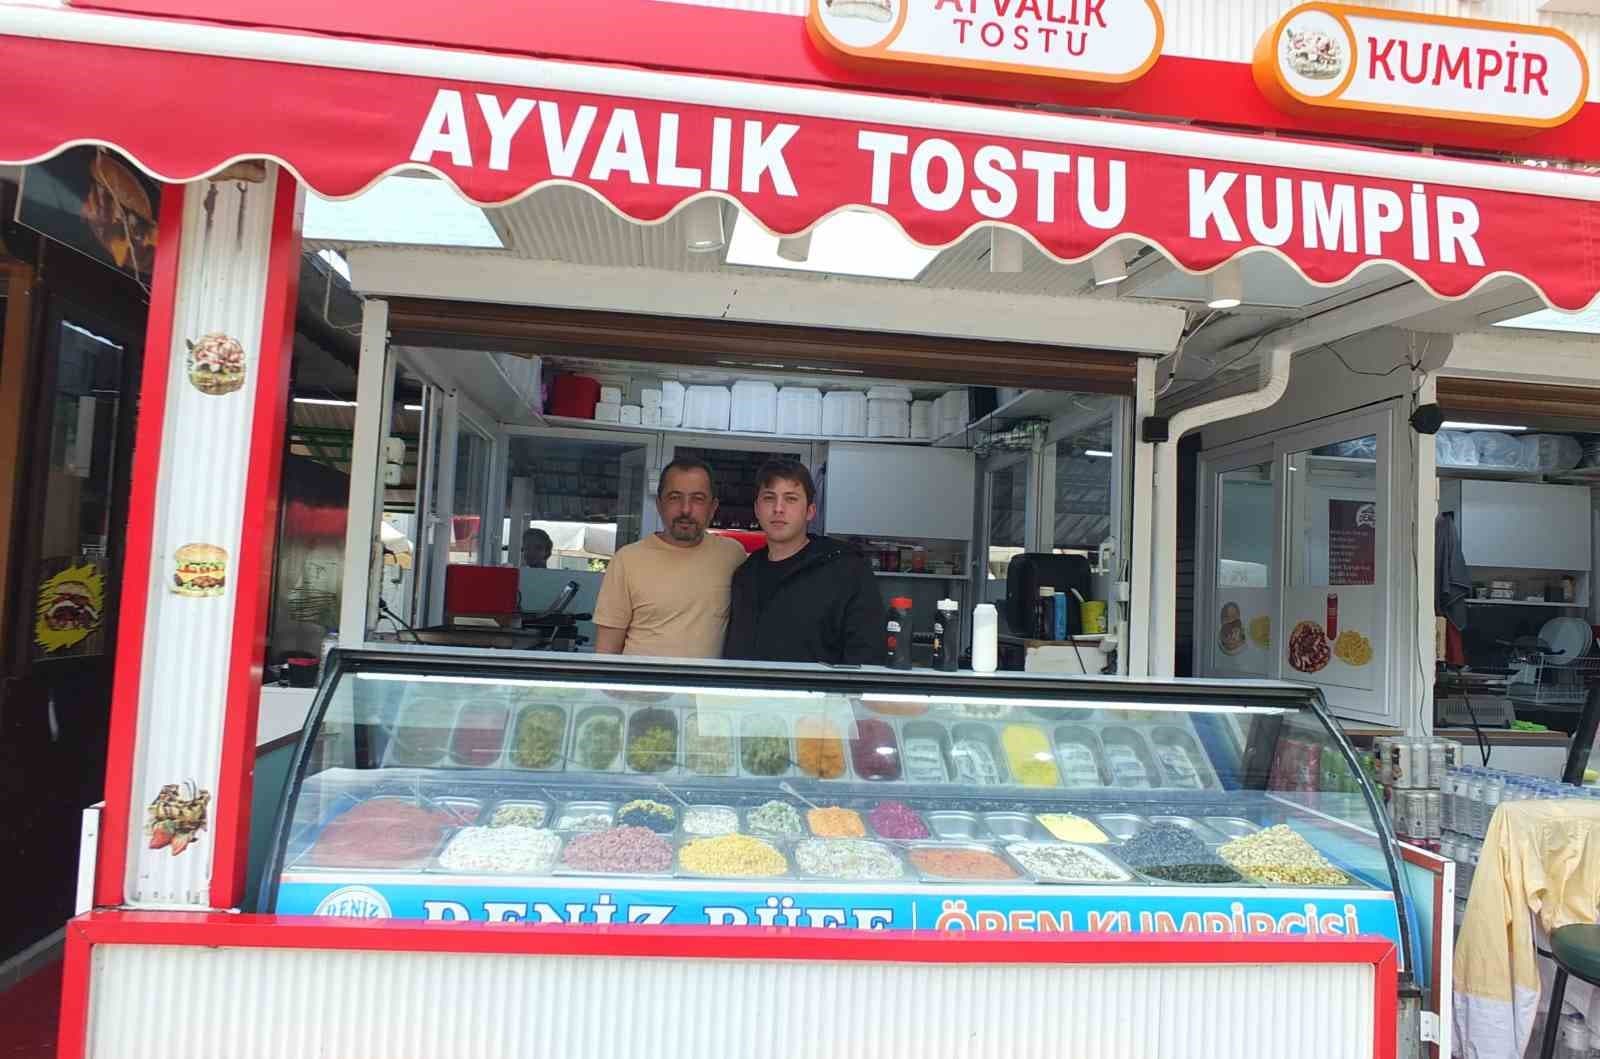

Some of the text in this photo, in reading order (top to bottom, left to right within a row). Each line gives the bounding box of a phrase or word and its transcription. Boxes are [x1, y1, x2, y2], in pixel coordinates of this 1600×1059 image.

[953, 18, 1088, 56] TOSTU
[1368, 36, 1549, 96] KUMPİR
[409, 88, 1486, 267] AYVALIK TOSTU KUMPİR
